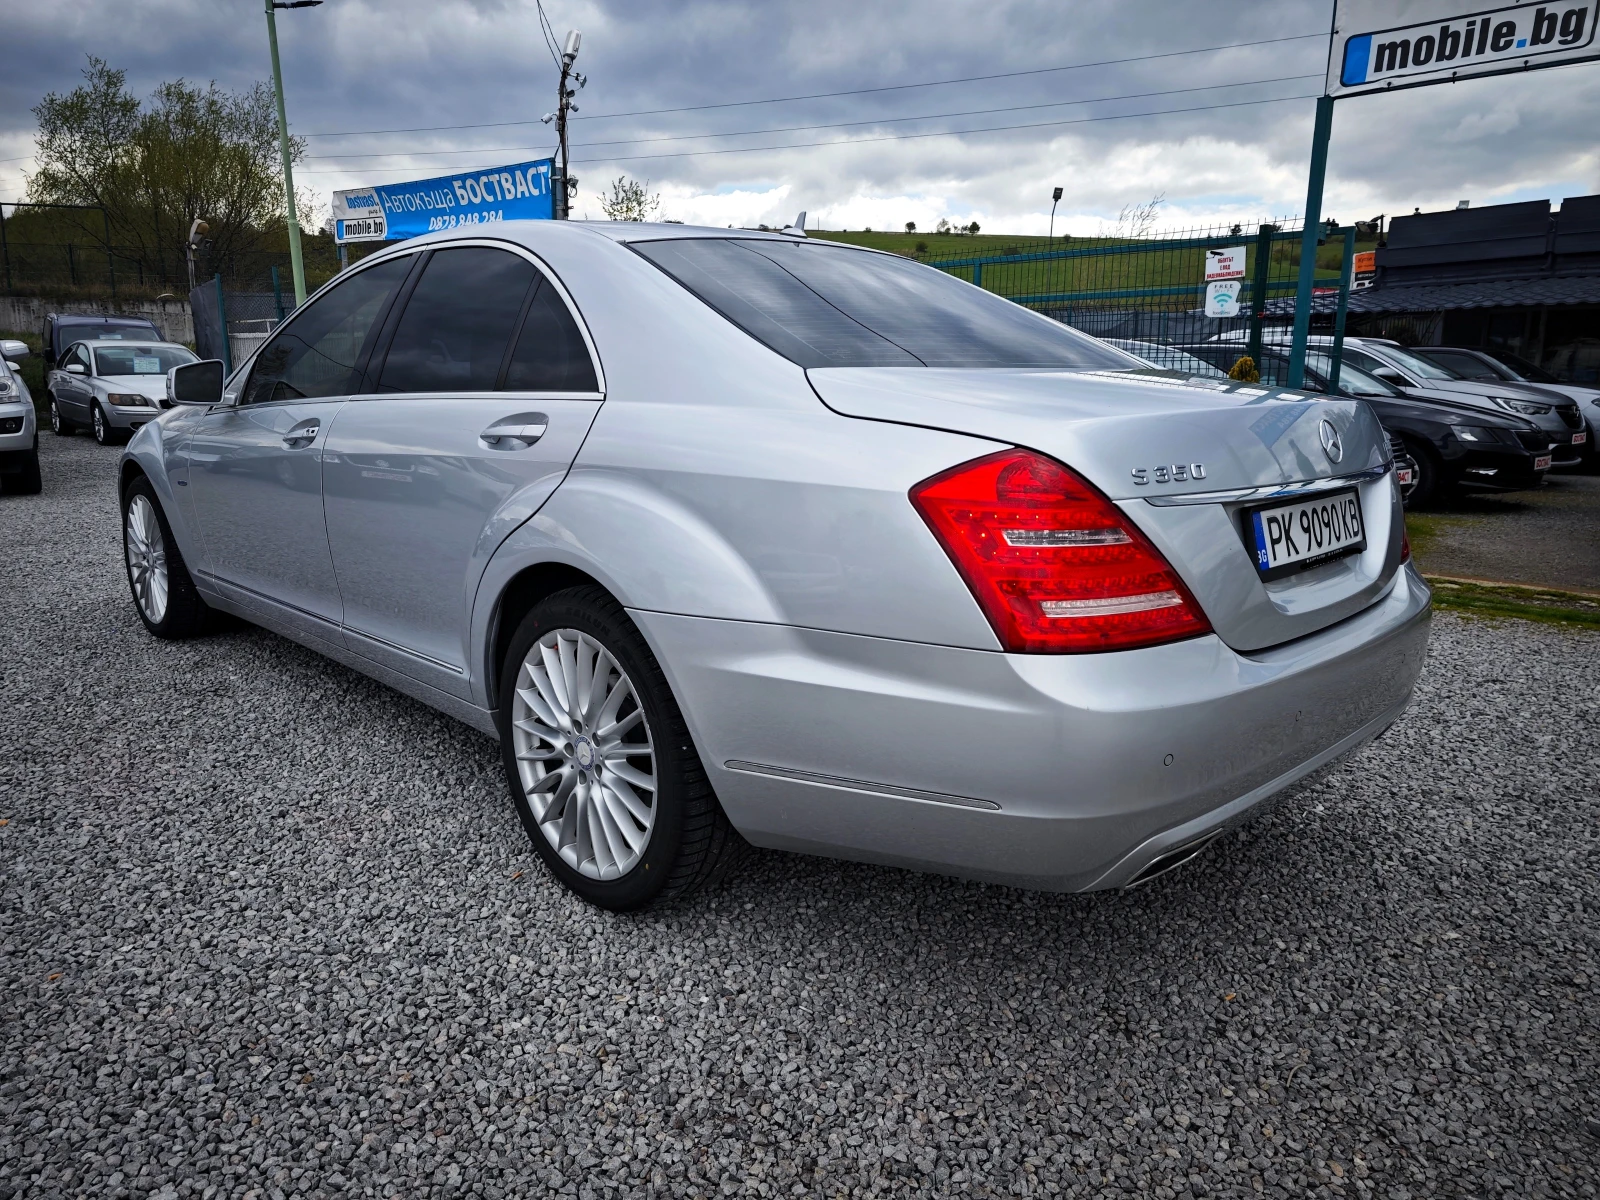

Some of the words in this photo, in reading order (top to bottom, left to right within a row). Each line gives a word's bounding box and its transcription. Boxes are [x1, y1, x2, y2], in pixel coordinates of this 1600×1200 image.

[1373, 6, 1588, 73] mobile.bg
[345, 220, 383, 236] mobile.bg
[428, 214, 456, 231] 0878
[1130, 467, 1150, 486] S
[1153, 462, 1207, 484] 350
